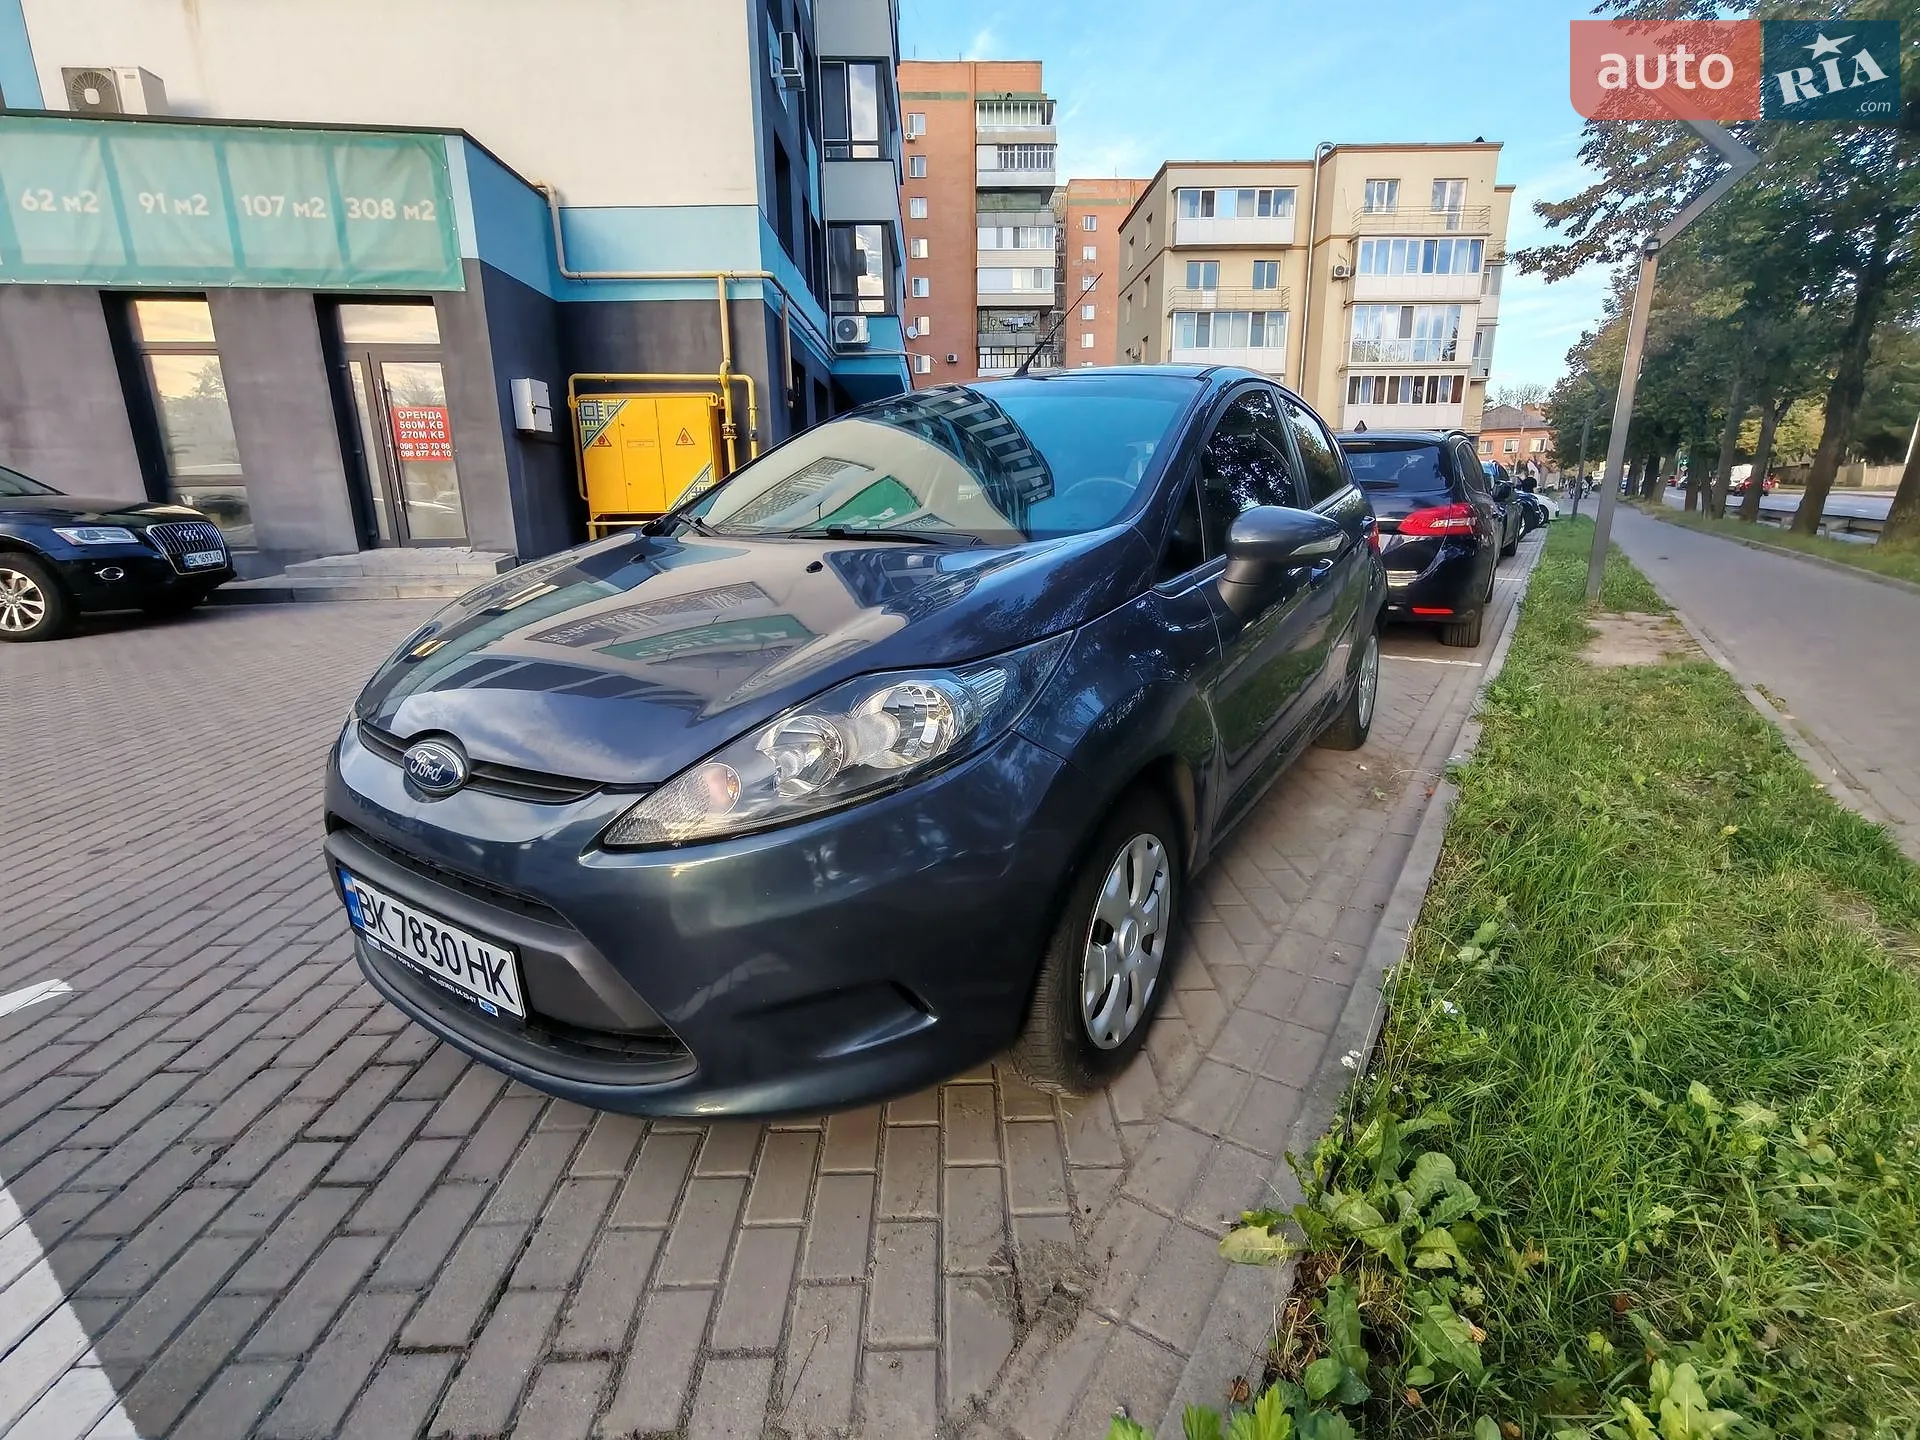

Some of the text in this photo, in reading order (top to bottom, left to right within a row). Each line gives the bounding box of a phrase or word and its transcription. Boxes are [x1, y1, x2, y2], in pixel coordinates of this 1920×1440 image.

[20, 188, 57, 212] 62
[138, 192, 167, 215] 91
[240, 194, 286, 218] 107
[344, 197, 396, 220] 308
[398, 411, 442, 421] ОРЕНДА
[401, 430, 446, 440] 270М.КВ
[410, 749, 446, 782] Ford
[354, 884, 396, 943] BK
[391, 908, 462, 976] 7830
[462, 940, 516, 1005] HK
